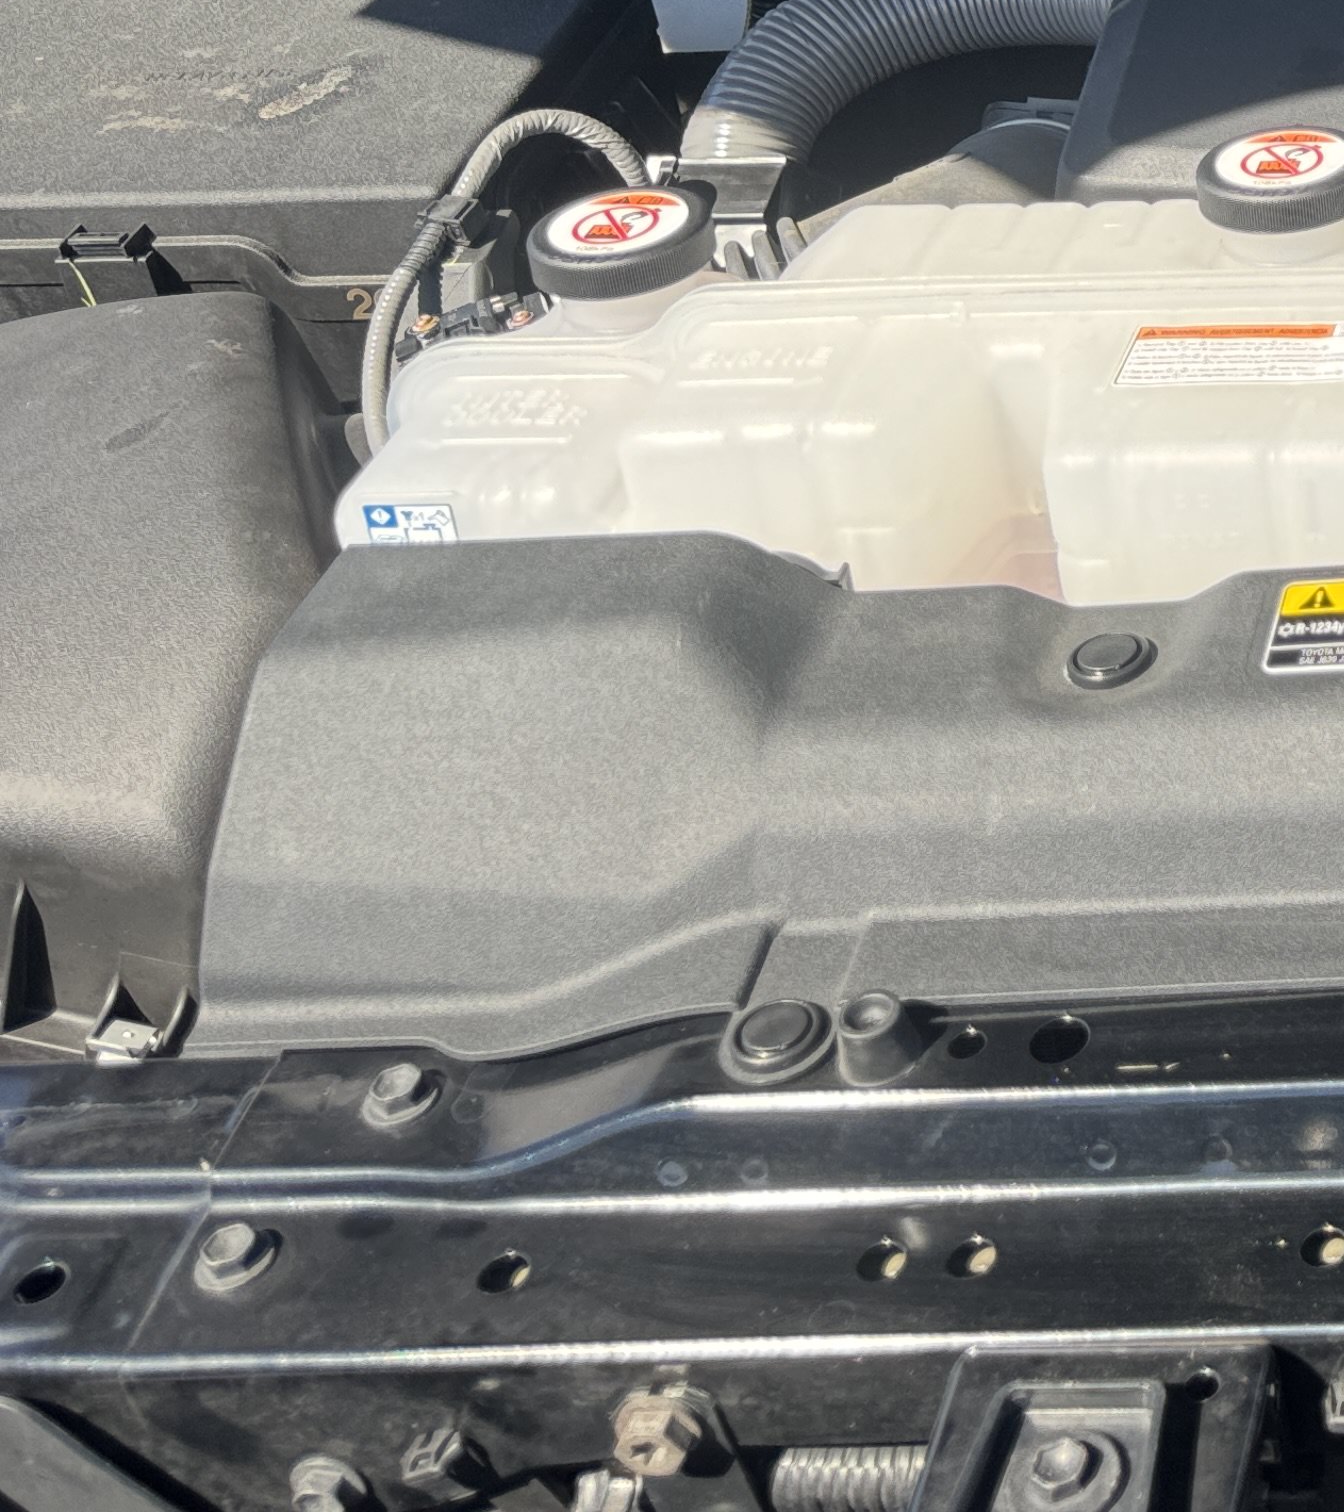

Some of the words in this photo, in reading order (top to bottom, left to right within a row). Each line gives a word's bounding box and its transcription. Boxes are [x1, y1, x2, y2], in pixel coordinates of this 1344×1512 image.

[688, 344, 834, 370] ENGINE
[1301, 648, 1335, 657] TOYOTA
[1299, 656, 1315, 665] SAE
